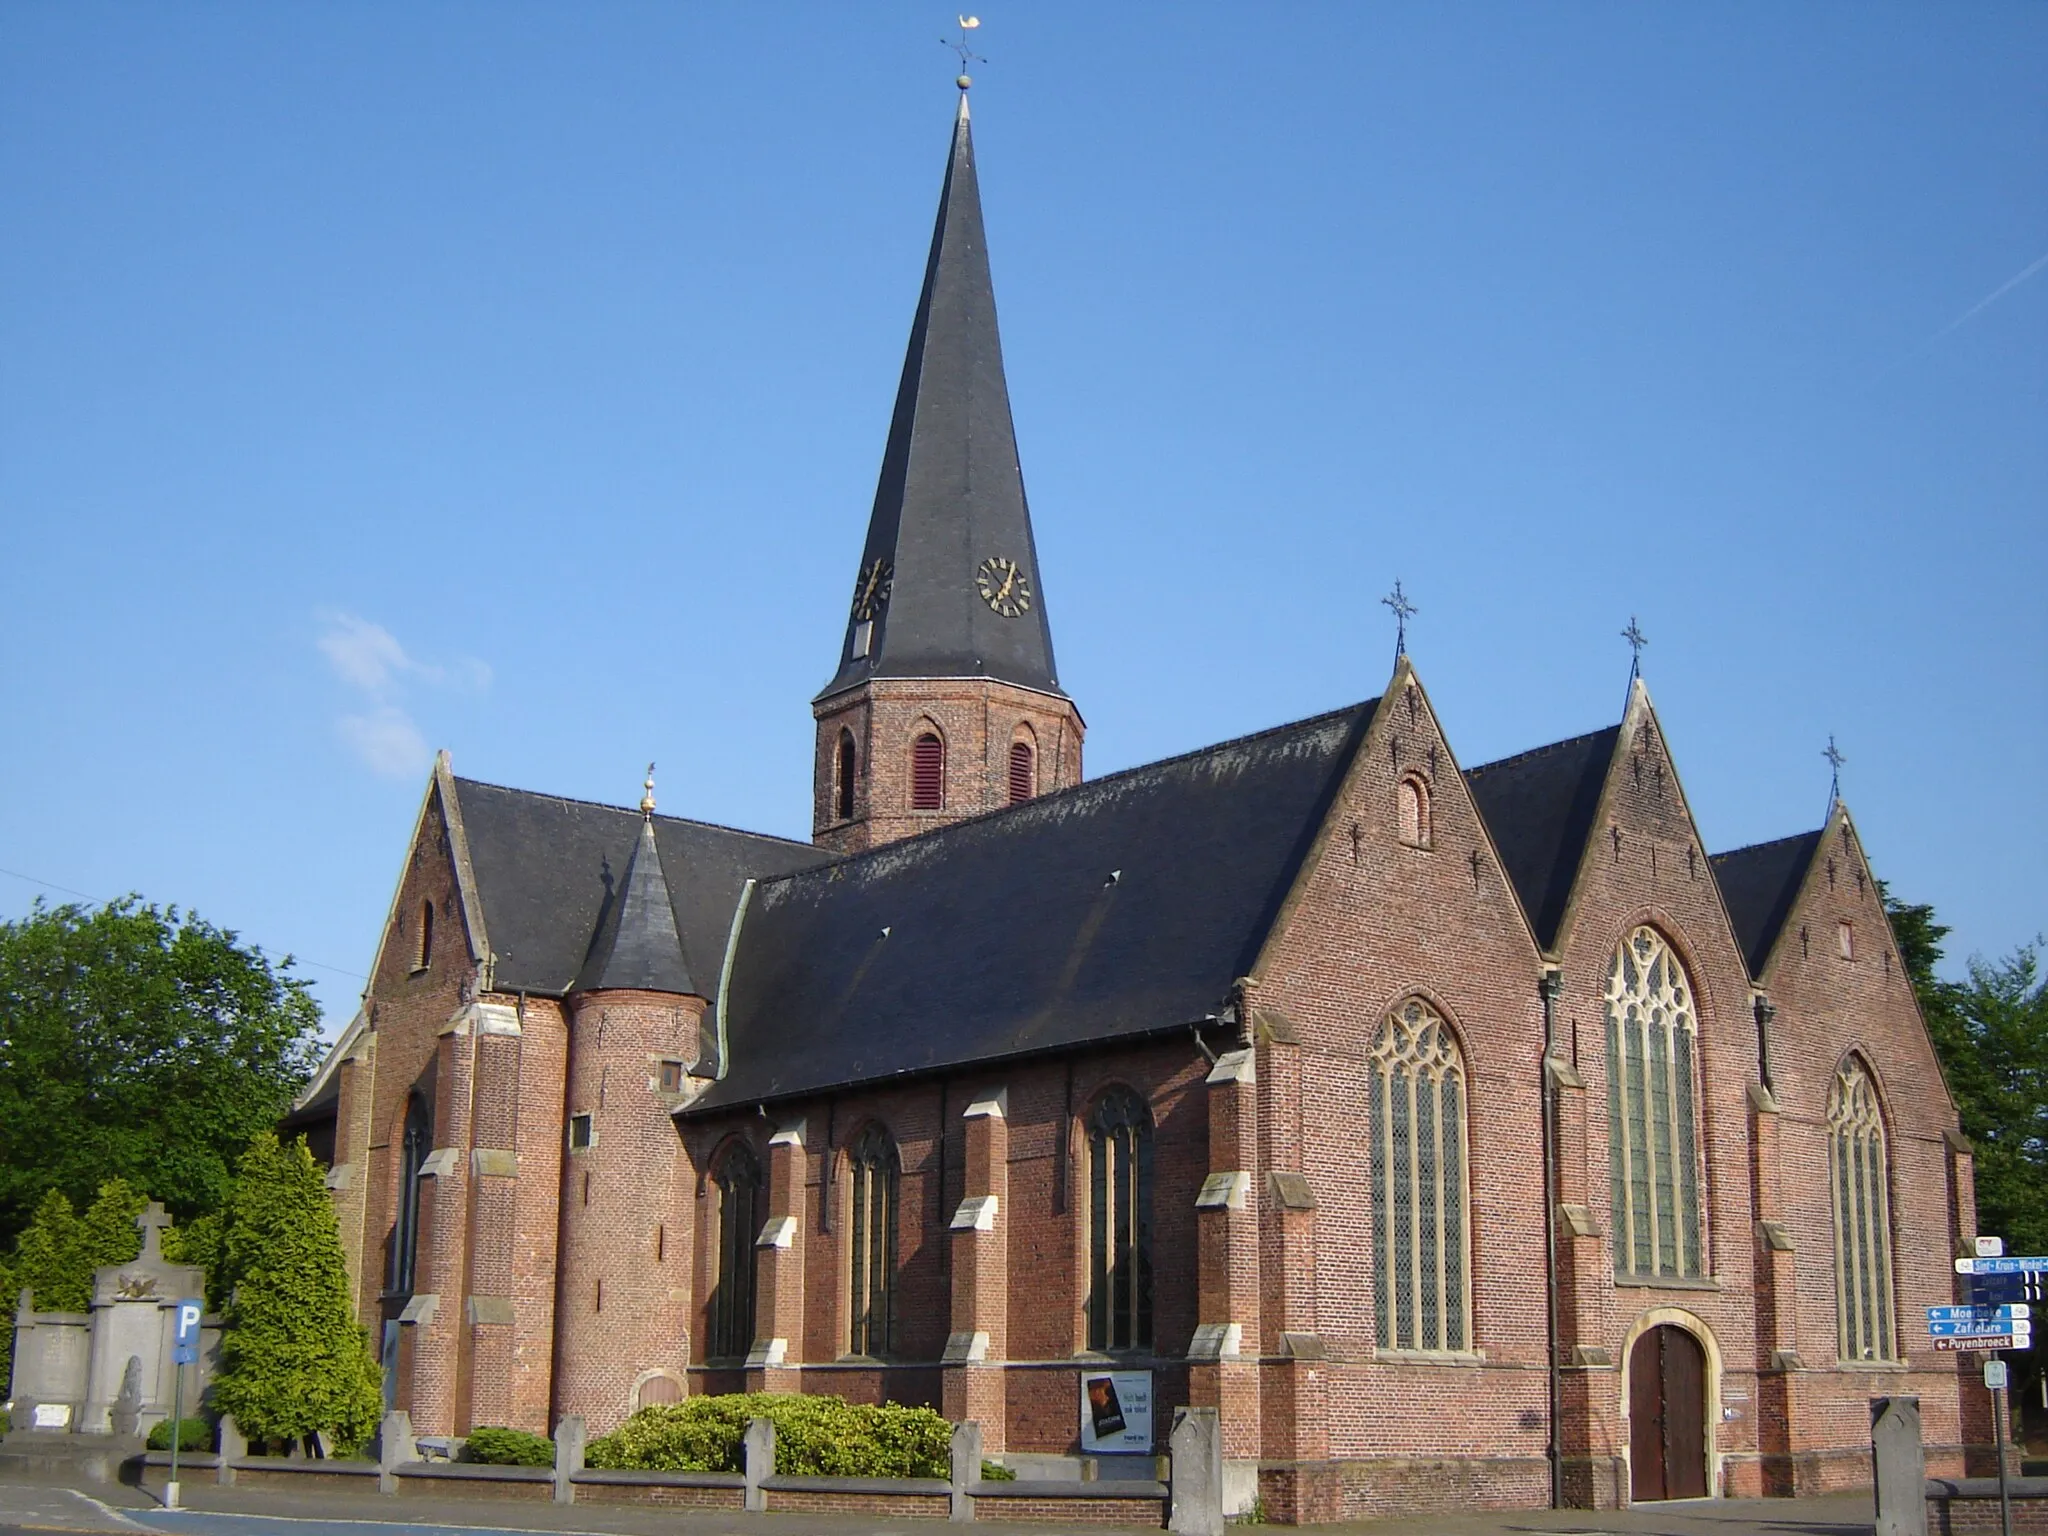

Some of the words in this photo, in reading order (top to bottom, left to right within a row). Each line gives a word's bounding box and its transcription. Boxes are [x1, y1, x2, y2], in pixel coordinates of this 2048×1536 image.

[1950, 1308, 2002, 1319] Moerbeke
[180, 1306, 200, 1338] P
[1948, 1337, 2010, 1350] Puyenbroeck
